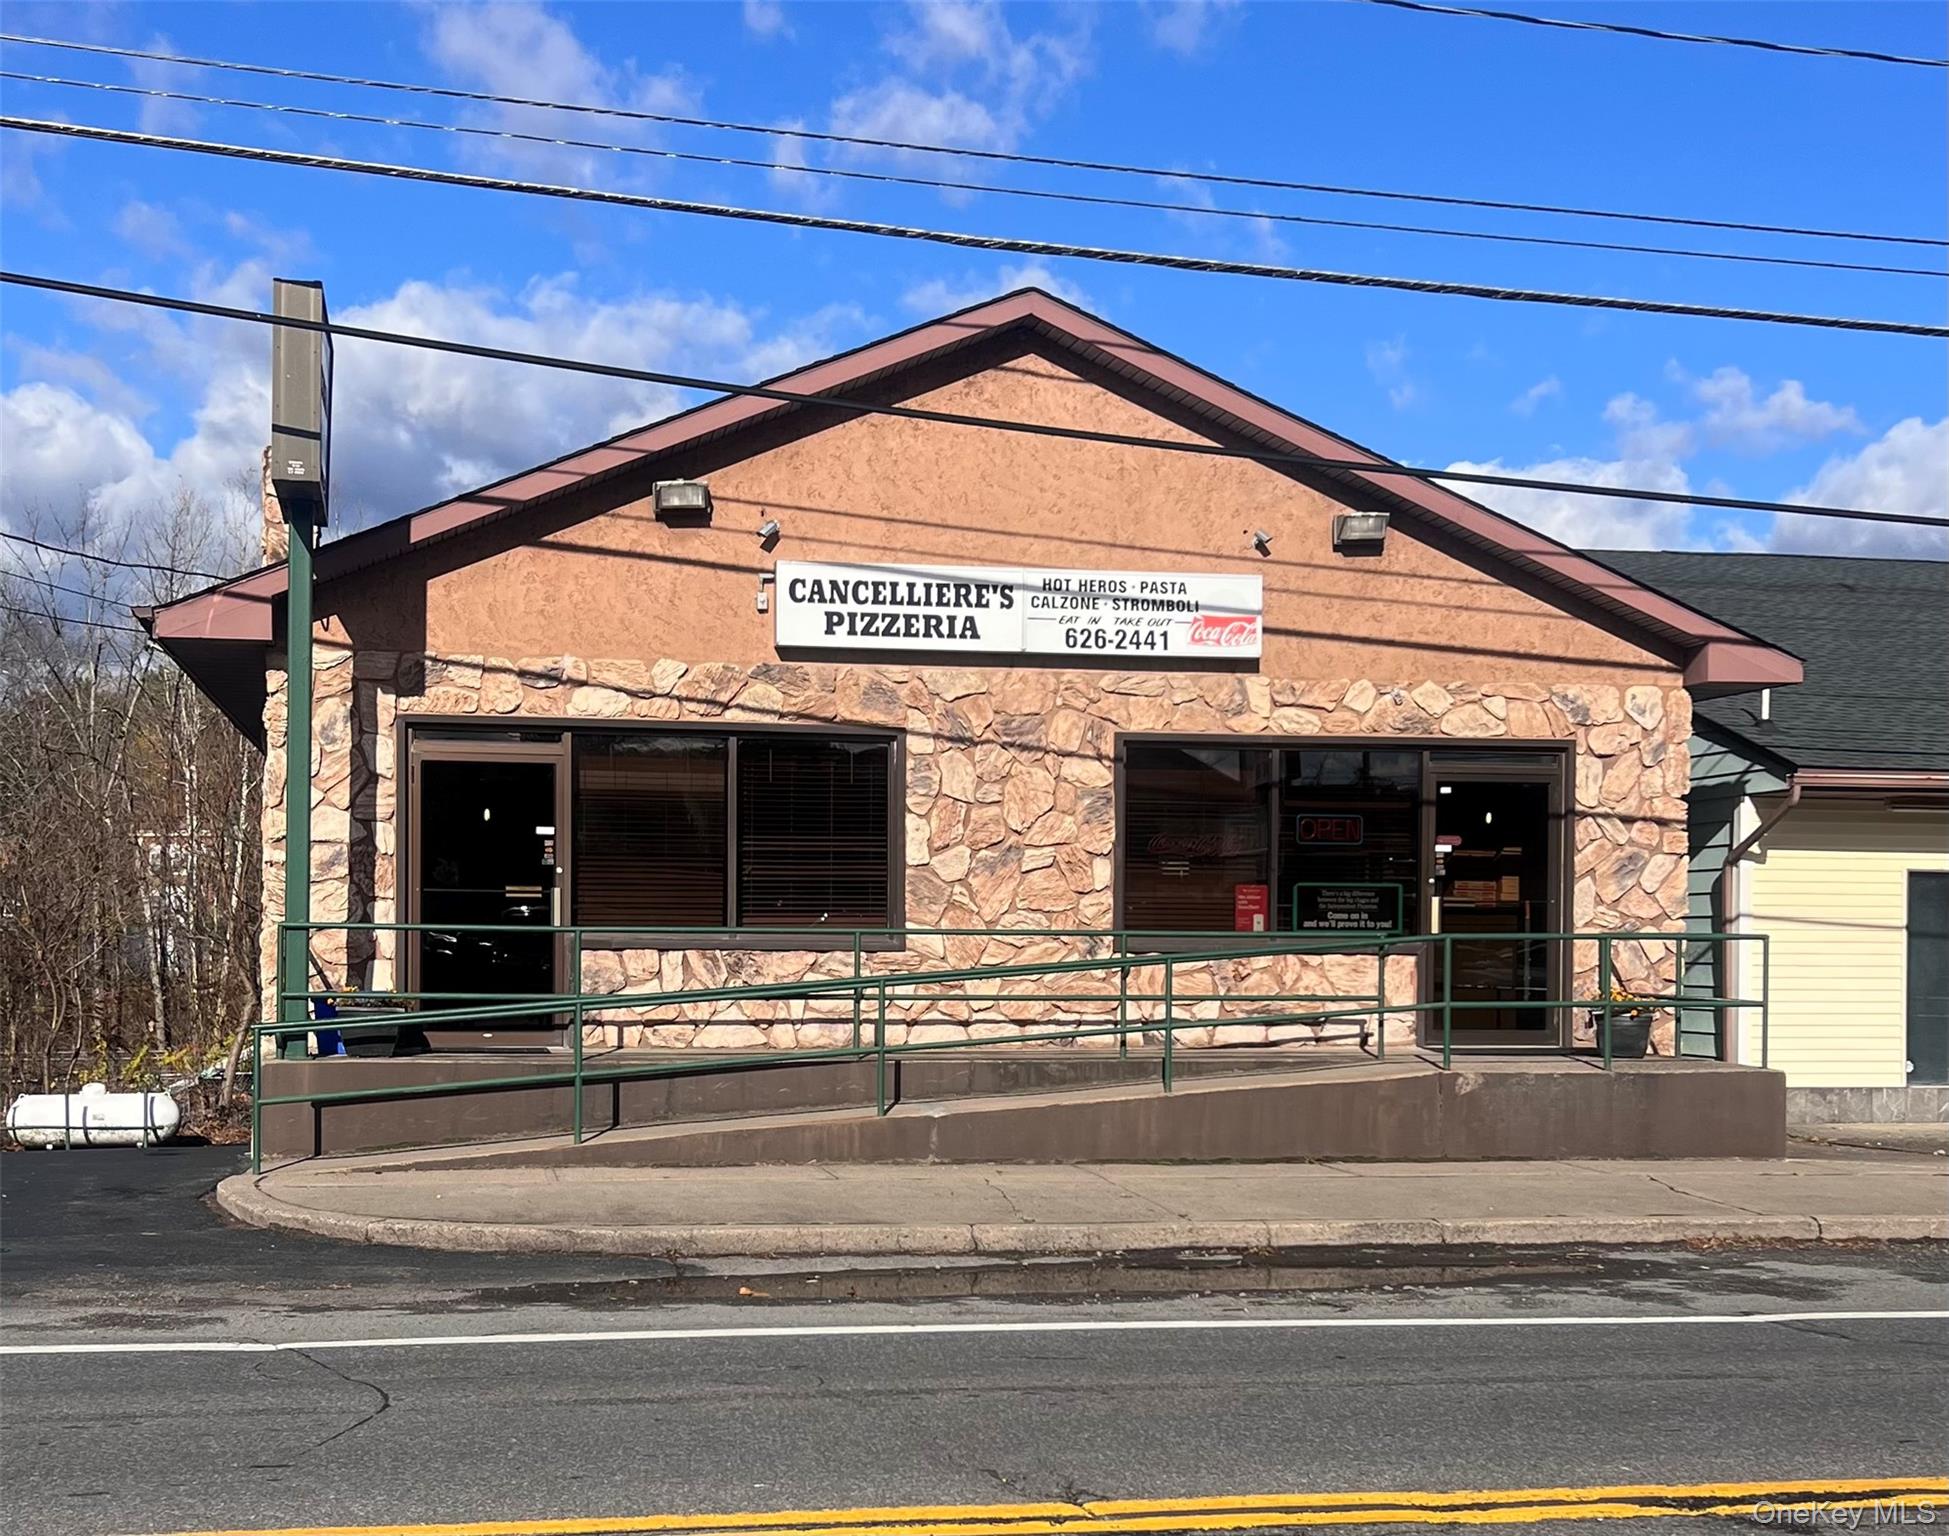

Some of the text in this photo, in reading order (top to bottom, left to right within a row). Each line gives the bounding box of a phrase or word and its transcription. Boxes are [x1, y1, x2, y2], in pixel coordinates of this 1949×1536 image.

[788, 578, 1015, 610] CANCELLIERE'S
[1042, 578, 1187, 595] HOT HEROS PASTA
[1031, 595, 1199, 612] CALZONE STROMBOLI
[824, 611, 981, 640] PIZZERIA
[1058, 615, 1173, 627] EAT IN TAKE OUT
[1065, 628, 1168, 651] 626-2441
[1301, 817, 1361, 841] OPEN
[1327, 911, 1349, 920] Come
